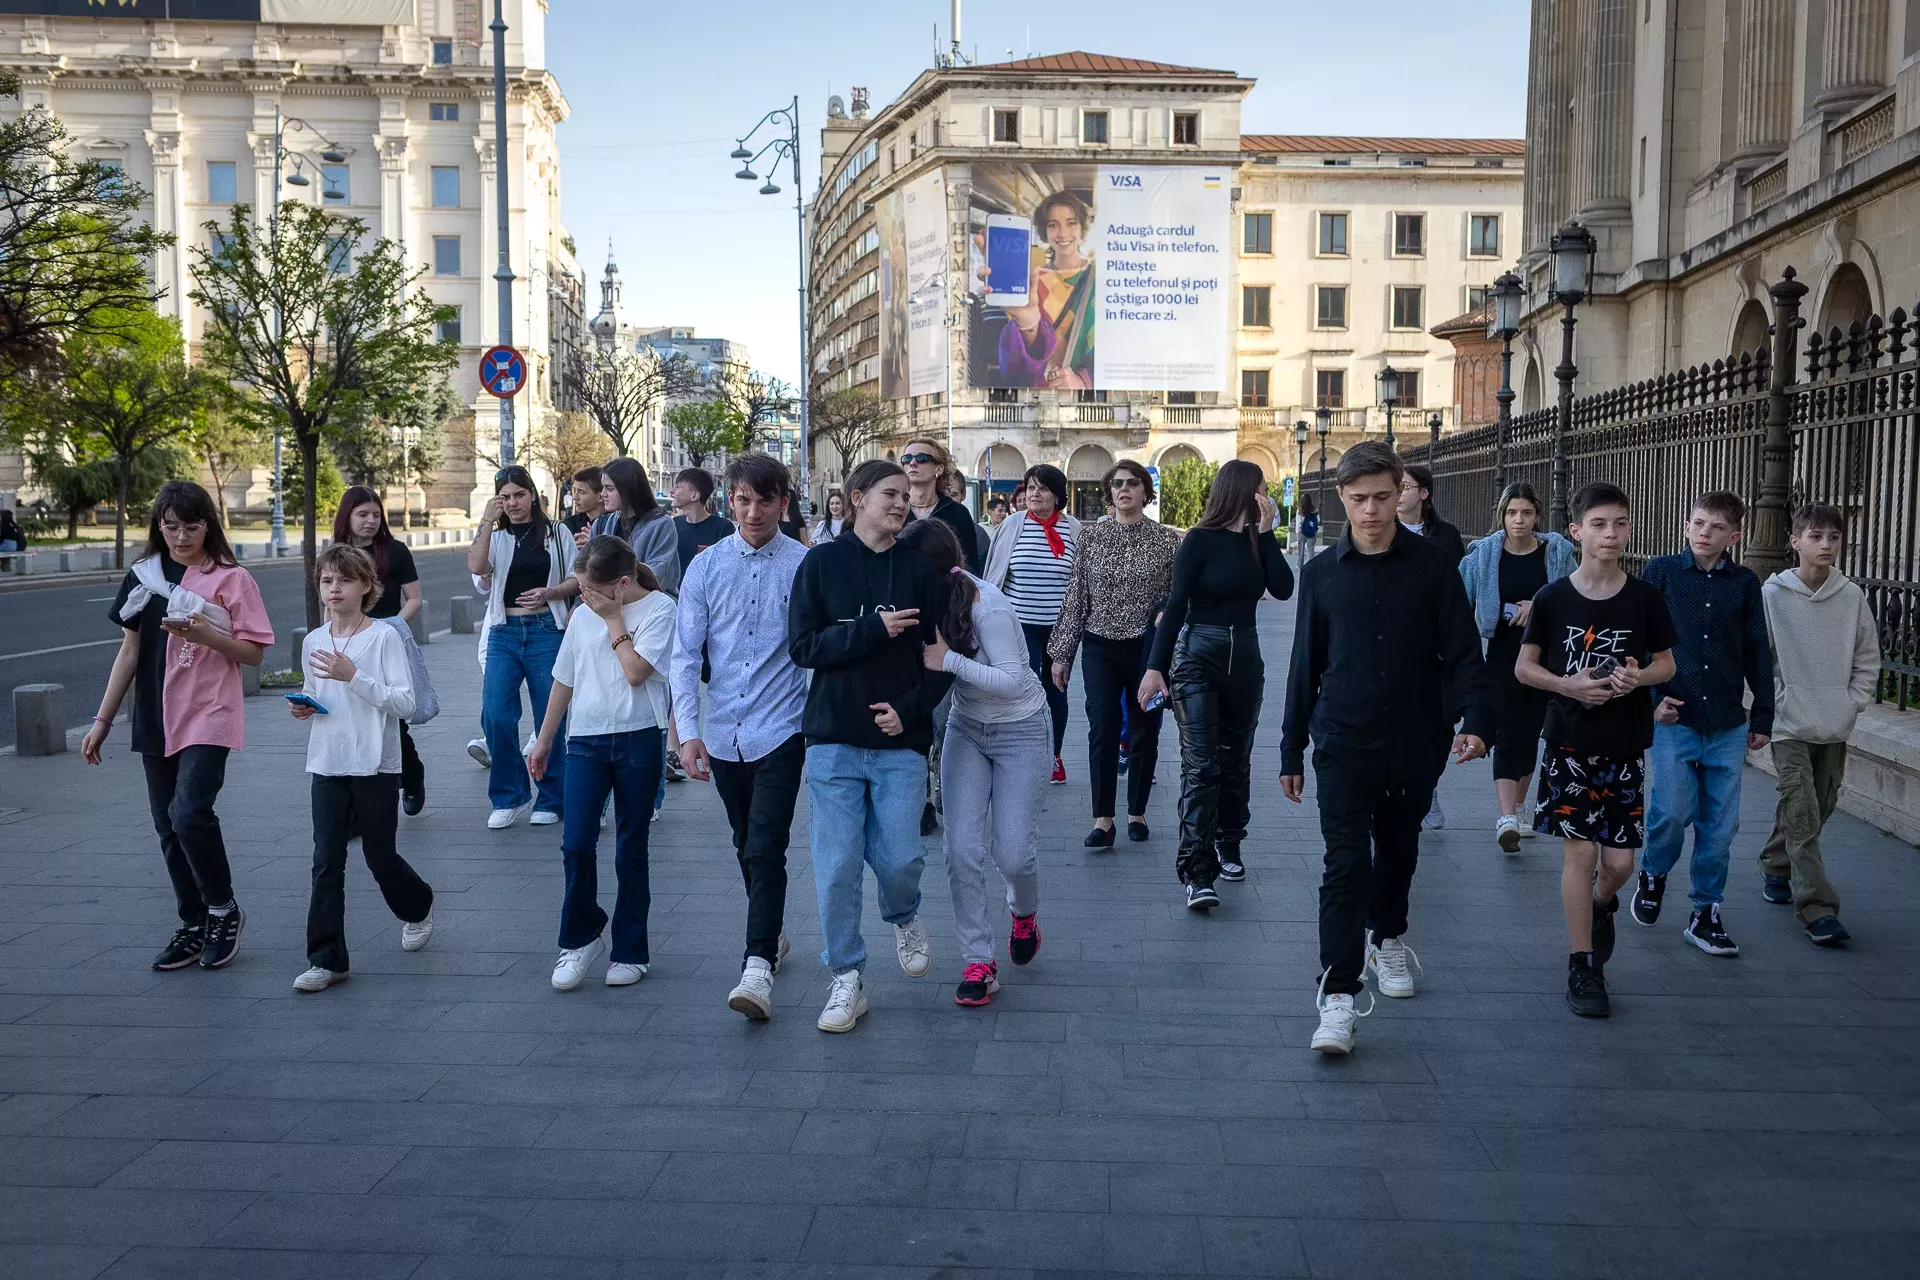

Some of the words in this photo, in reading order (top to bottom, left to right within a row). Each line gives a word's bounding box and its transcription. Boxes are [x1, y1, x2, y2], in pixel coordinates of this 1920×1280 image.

[1110, 175, 1141, 187] VISA
[1107, 224, 1154, 238] Adaugă
[1156, 225, 1195, 236] cardul
[1107, 240, 1127, 251] tău
[1130, 241, 1155, 252] Visa
[1157, 241, 1169, 252] în
[1171, 241, 1219, 253] telefon.
[1106, 259, 1157, 274] Plătește
[1011, 285, 1026, 293] VISA
[1106, 278, 1121, 288] cu
[1124, 276, 1179, 288] telefonul
[1181, 277, 1191, 291] și
[1193, 277, 1218, 291] poți
[1105, 292, 1149, 306] câștiga
[1151, 293, 1182, 305] 1000
[1184, 293, 1199, 305] lei
[1105, 308, 1117, 320] în
[1119, 308, 1162, 321] fiecare
[1163, 309, 1177, 321] zi.
[1565, 651, 1611, 673] WIT
